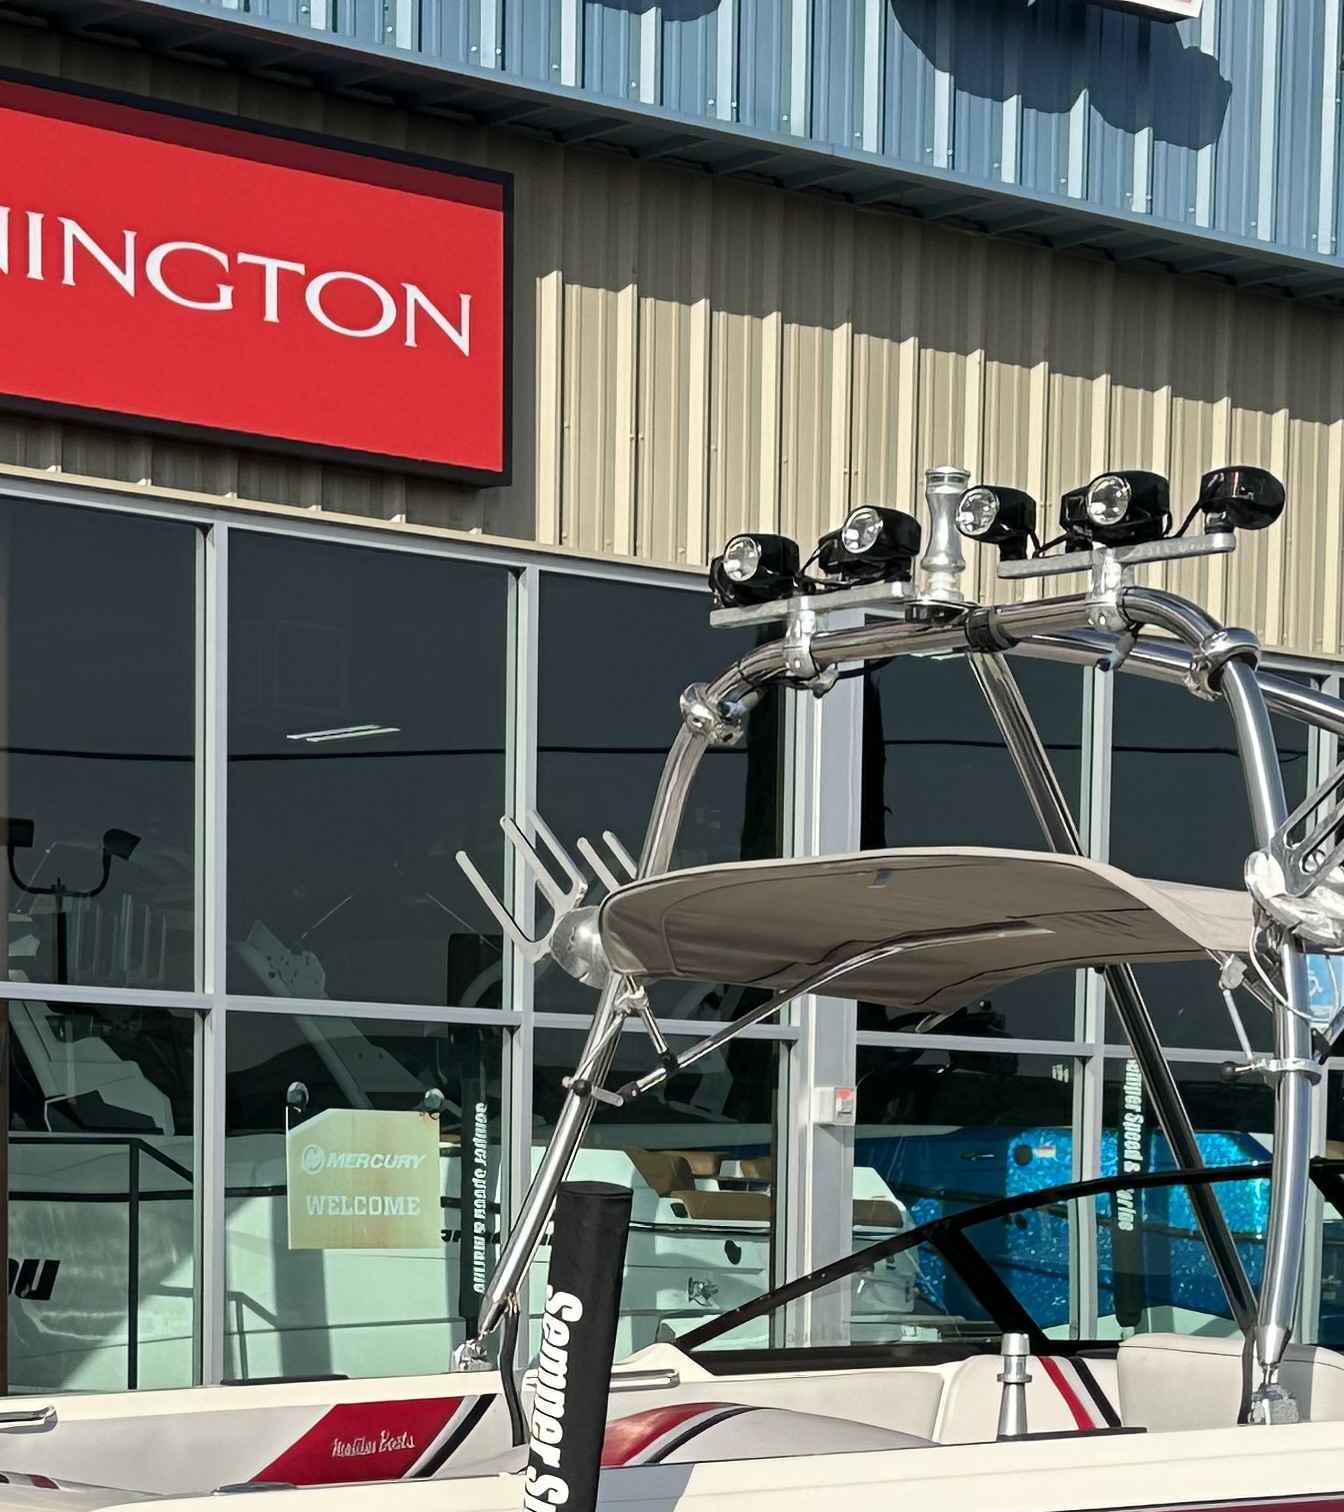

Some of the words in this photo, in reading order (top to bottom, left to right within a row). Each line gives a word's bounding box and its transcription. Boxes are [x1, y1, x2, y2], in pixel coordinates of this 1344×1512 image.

[326, 1151, 427, 1169] MERCURY
[306, 1193, 422, 1217] WELCOME
[528, 1284, 584, 1468] Semper
